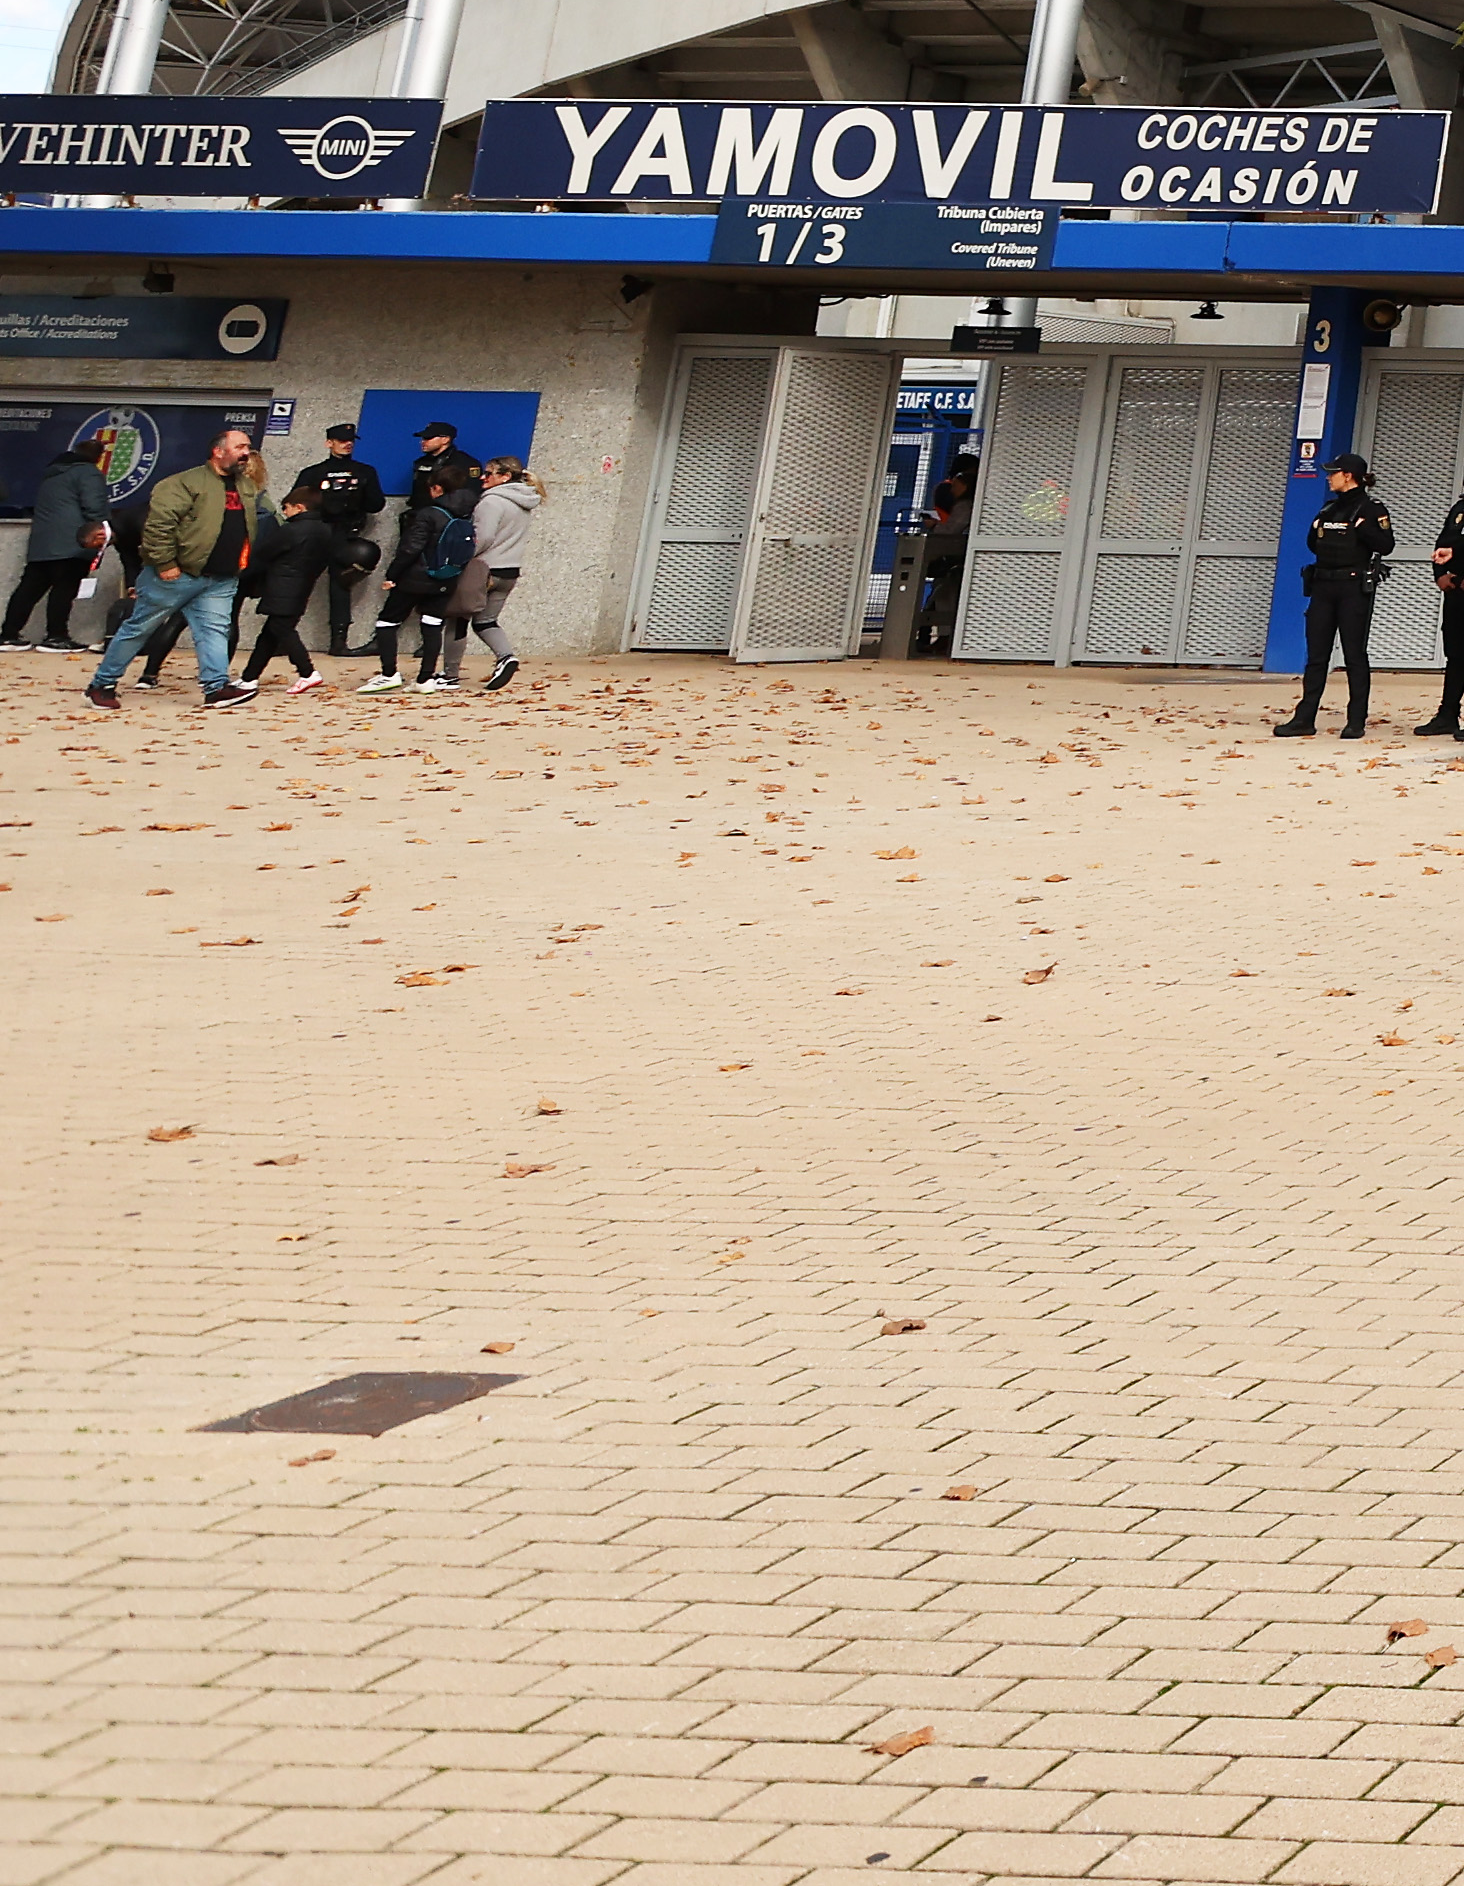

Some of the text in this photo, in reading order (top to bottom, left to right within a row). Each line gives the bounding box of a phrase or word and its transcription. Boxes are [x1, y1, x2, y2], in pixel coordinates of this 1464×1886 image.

[1138, 114, 1379, 153] COCHES DE
[0, 123, 251, 167] VEHINTER
[320, 139, 366, 156] MINI
[555, 106, 1094, 201] YAMOVIL
[1122, 161, 1359, 207] OCASIÓN
[937, 206, 1044, 220] Tribuna Cubierta
[980, 220, 1042, 235] (Impares)
[951, 242, 1039, 255] Covered Tribune
[985, 256, 1036, 269] (Uneven)
[39, 313, 129, 327] Acreditaciones
[1314, 319, 1331, 353] 3
